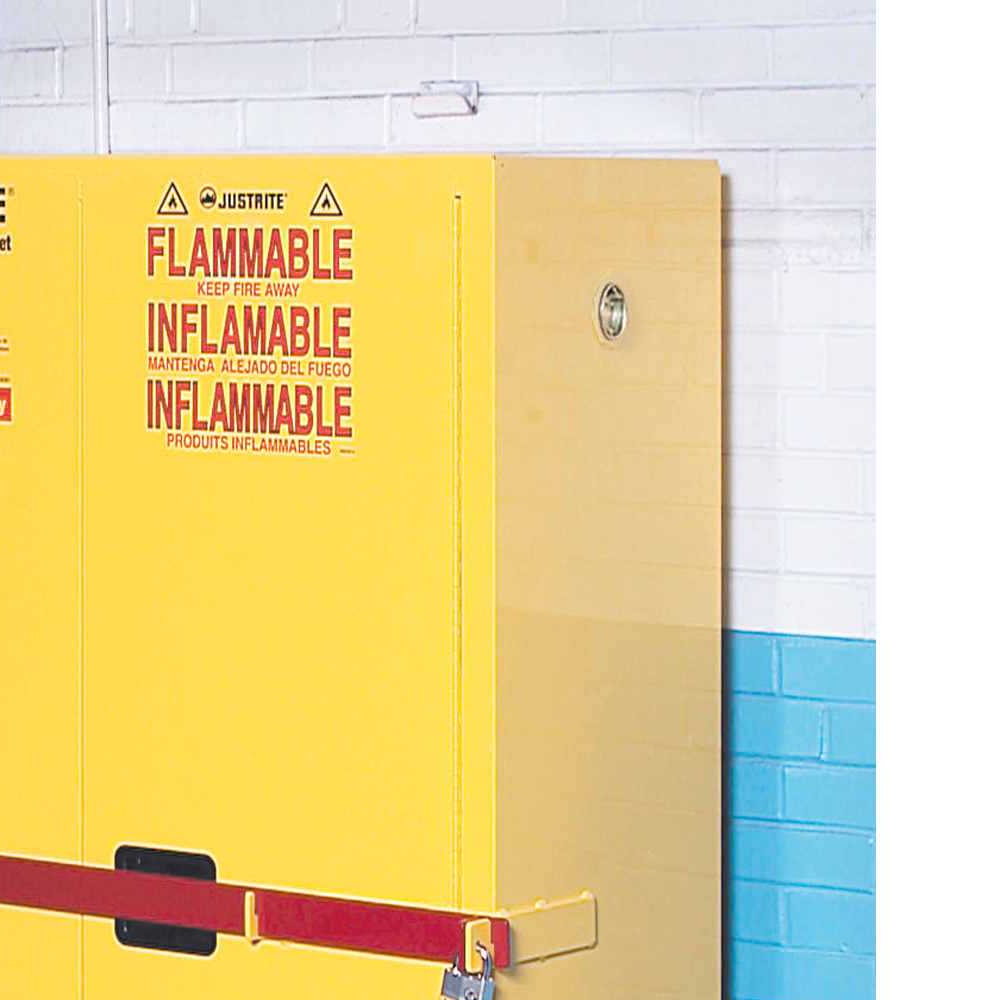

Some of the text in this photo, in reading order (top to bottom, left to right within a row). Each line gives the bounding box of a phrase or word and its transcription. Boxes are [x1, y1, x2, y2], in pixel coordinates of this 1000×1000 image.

[218, 192, 284, 210] JUSTRITE
[147, 226, 353, 280] FLAMMABLE
[197, 281, 300, 297] KEEP FIRE AWAY
[147, 302, 352, 359] INFLAMABLE
[148, 356, 352, 378] MANTENGA ALEJADO DEL FUEGO
[147, 379, 353, 438] INFLAMMABLE
[167, 432, 332, 455] PRODUITS INFLAMMABLES
